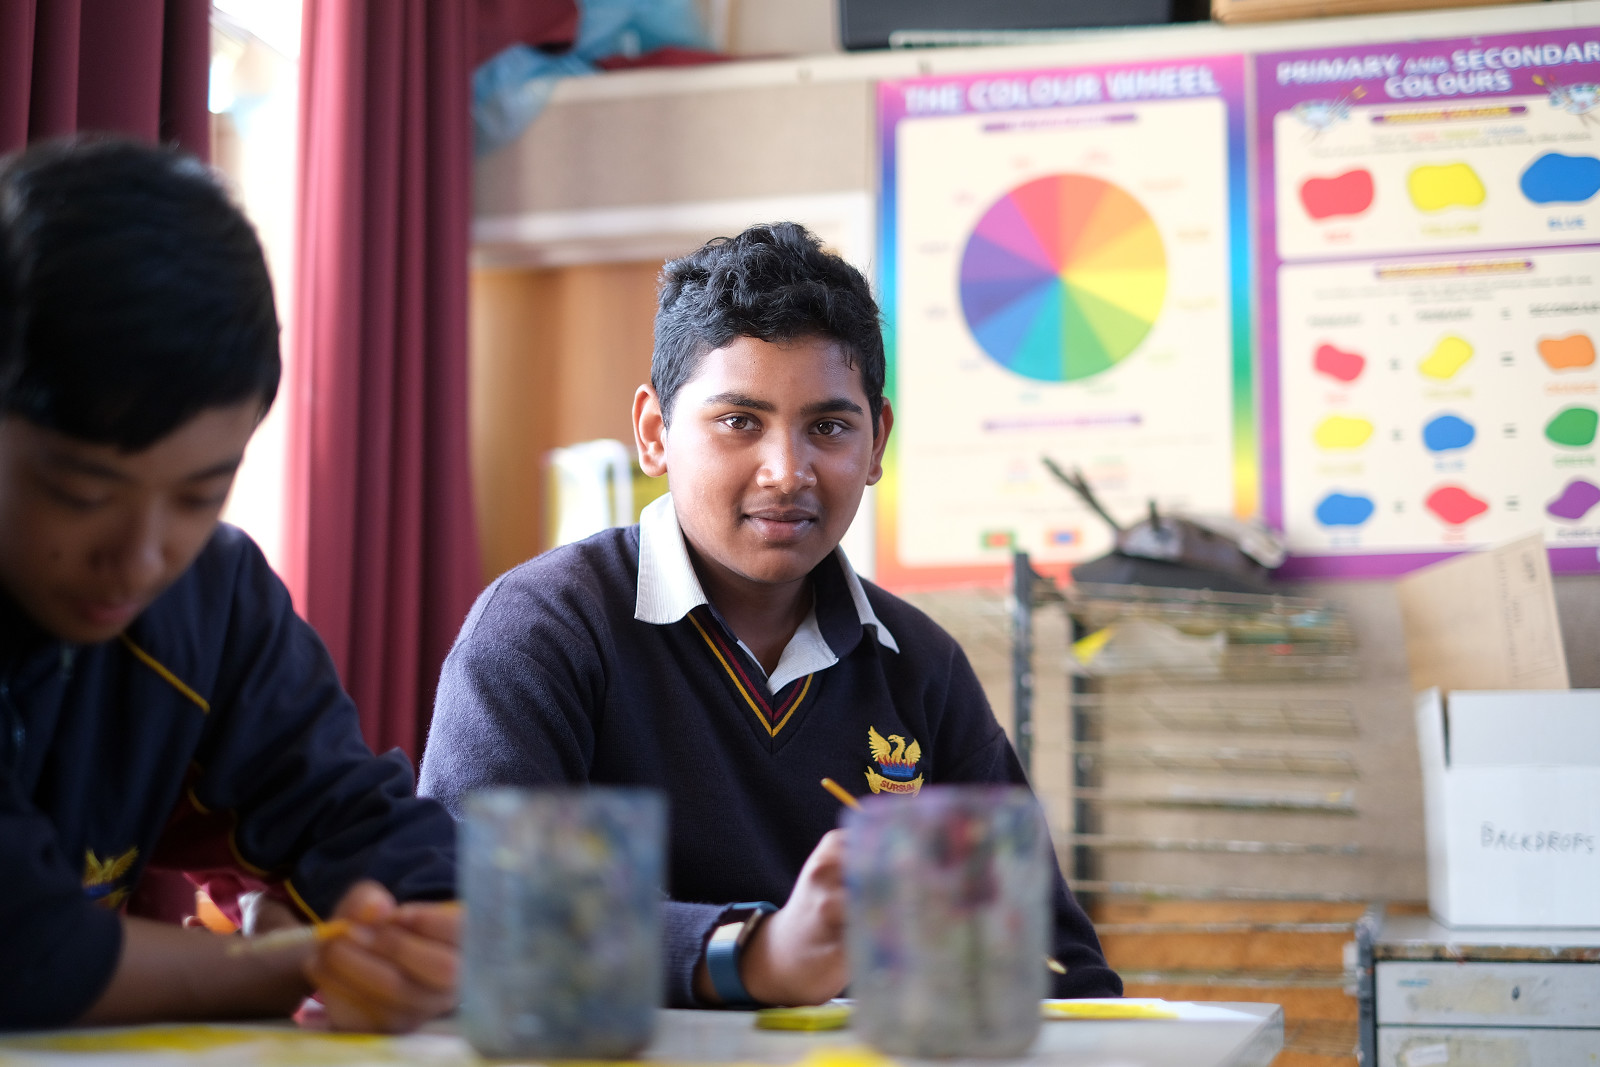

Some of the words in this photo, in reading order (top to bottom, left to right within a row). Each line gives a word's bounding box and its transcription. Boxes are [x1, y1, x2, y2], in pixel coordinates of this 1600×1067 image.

[1277, 54, 1401, 86] PRIMARY
[1403, 56, 1450, 75] AND
[1451, 41, 1600, 73] SECONDAR
[905, 84, 964, 115] THE
[967, 73, 1102, 112] COLOUR
[1104, 64, 1221, 101] WHEEL
[1384, 69, 1512, 99] COLOURS
[1480, 820, 1596, 854] BACKDROPS
